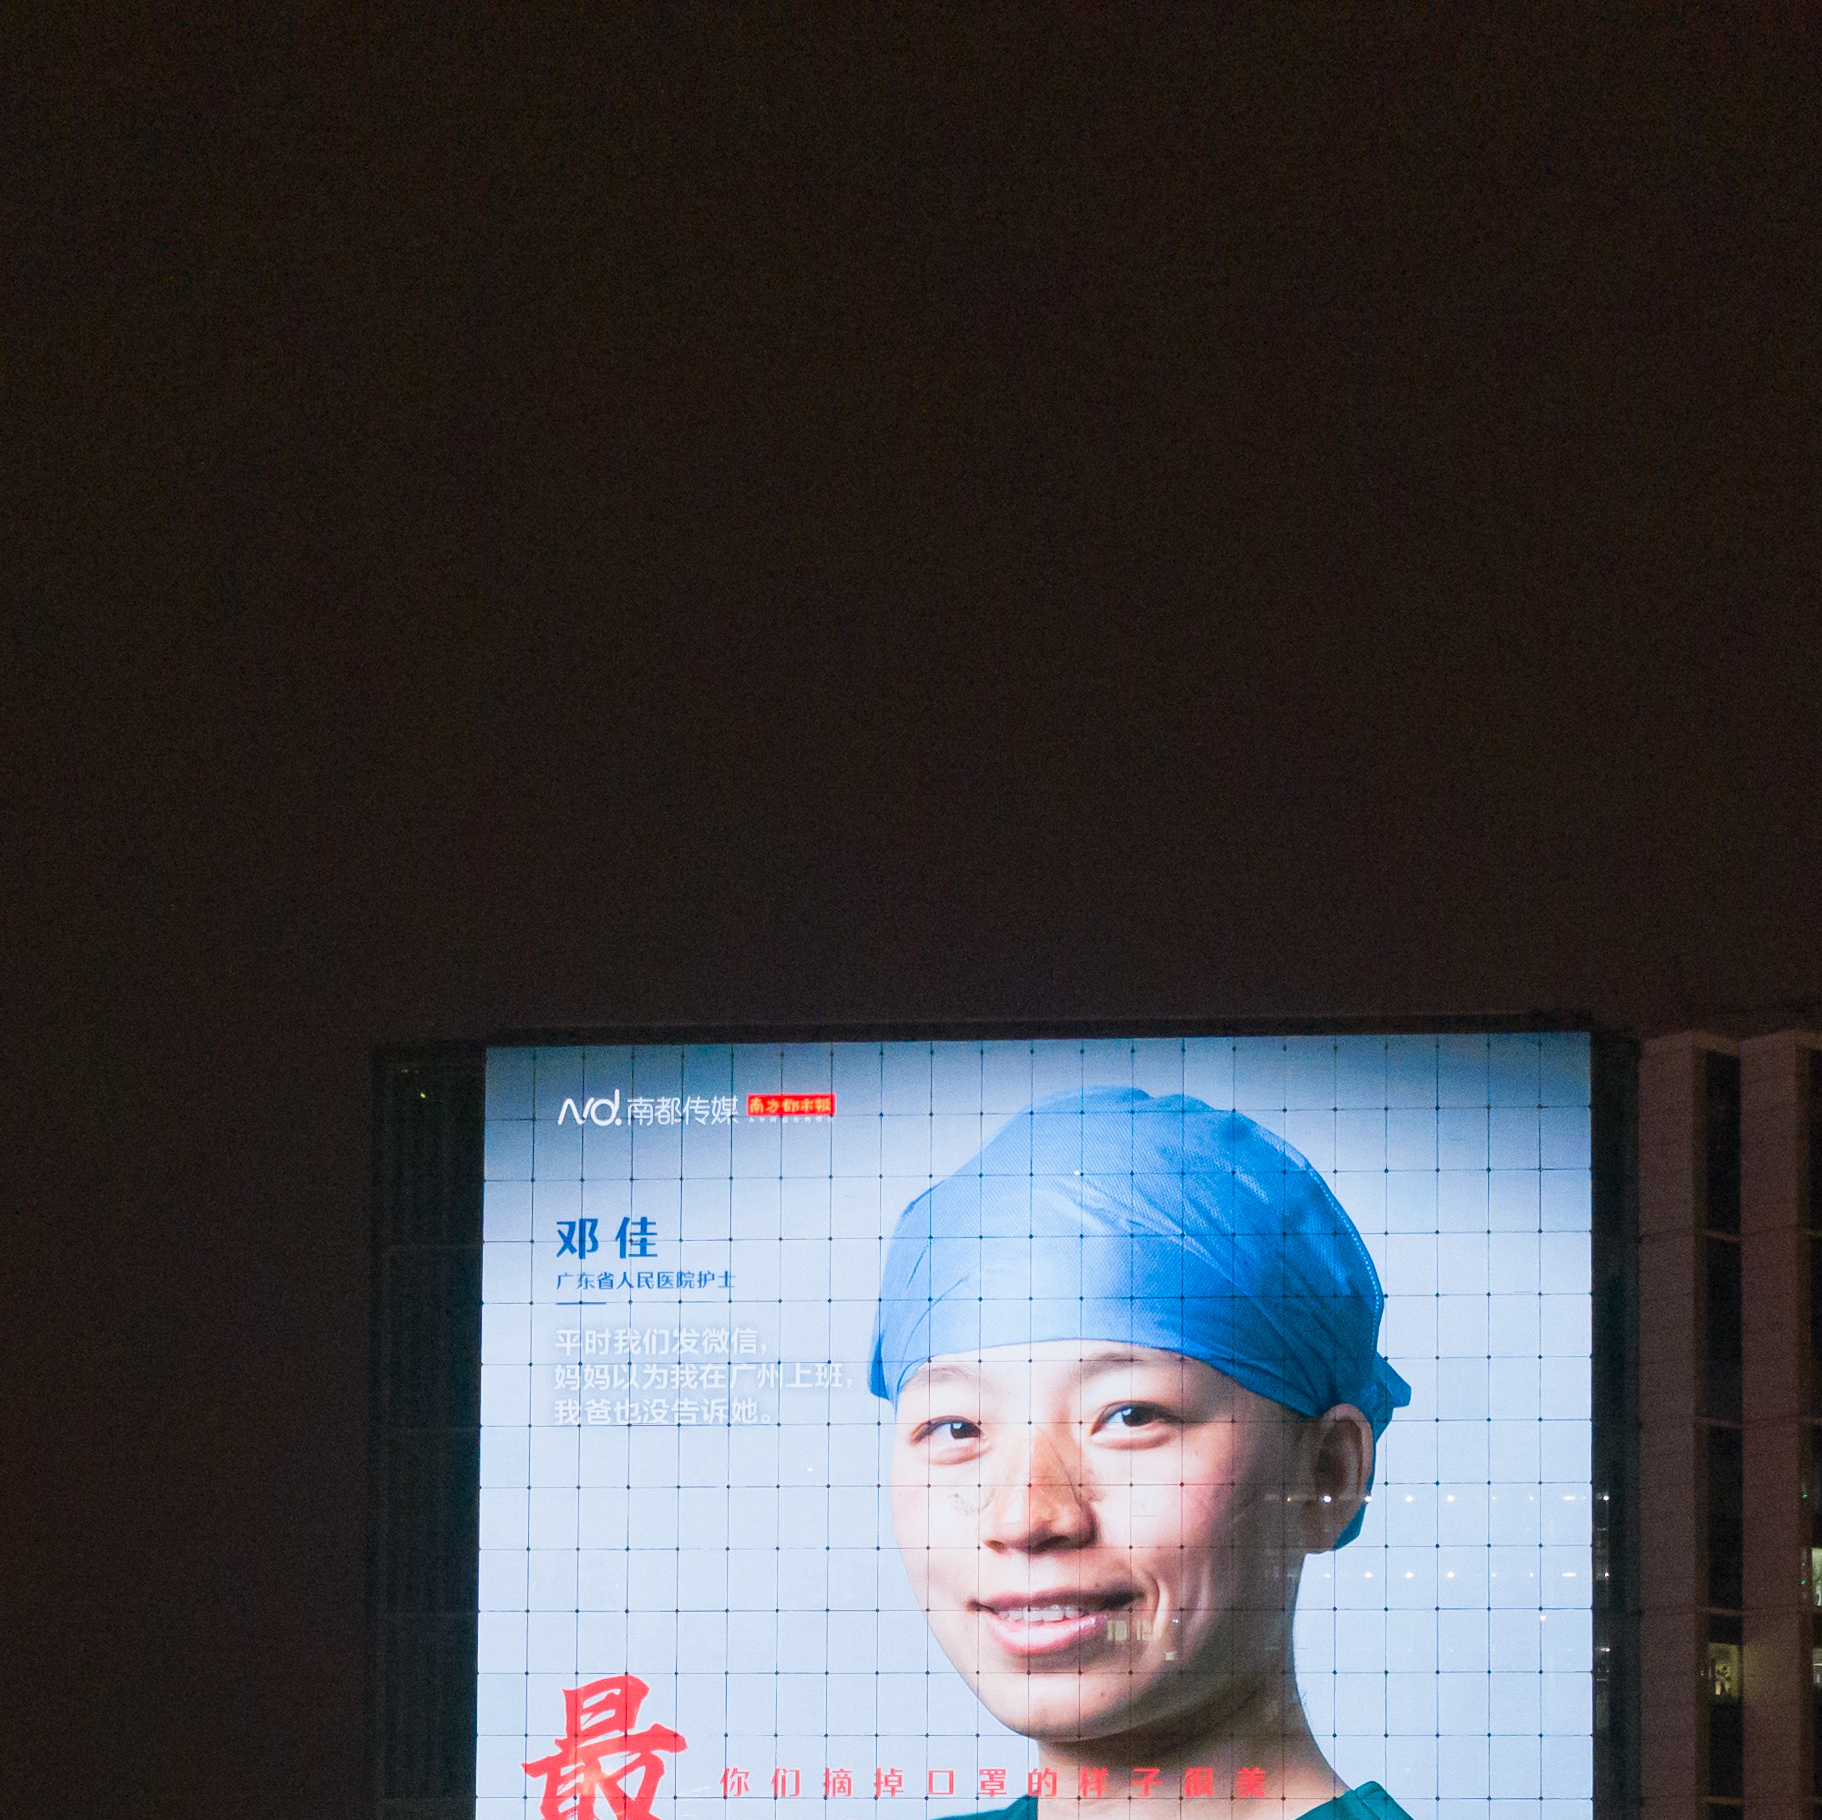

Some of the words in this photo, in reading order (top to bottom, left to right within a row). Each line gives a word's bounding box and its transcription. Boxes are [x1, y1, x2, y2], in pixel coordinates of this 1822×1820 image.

[627, 1095, 739, 1126] 南都传媒
[556, 1270, 736, 1290] 广东省人民医院护士
[720, 1767, 1266, 1798] 你们摘掉口罩的样子很美
